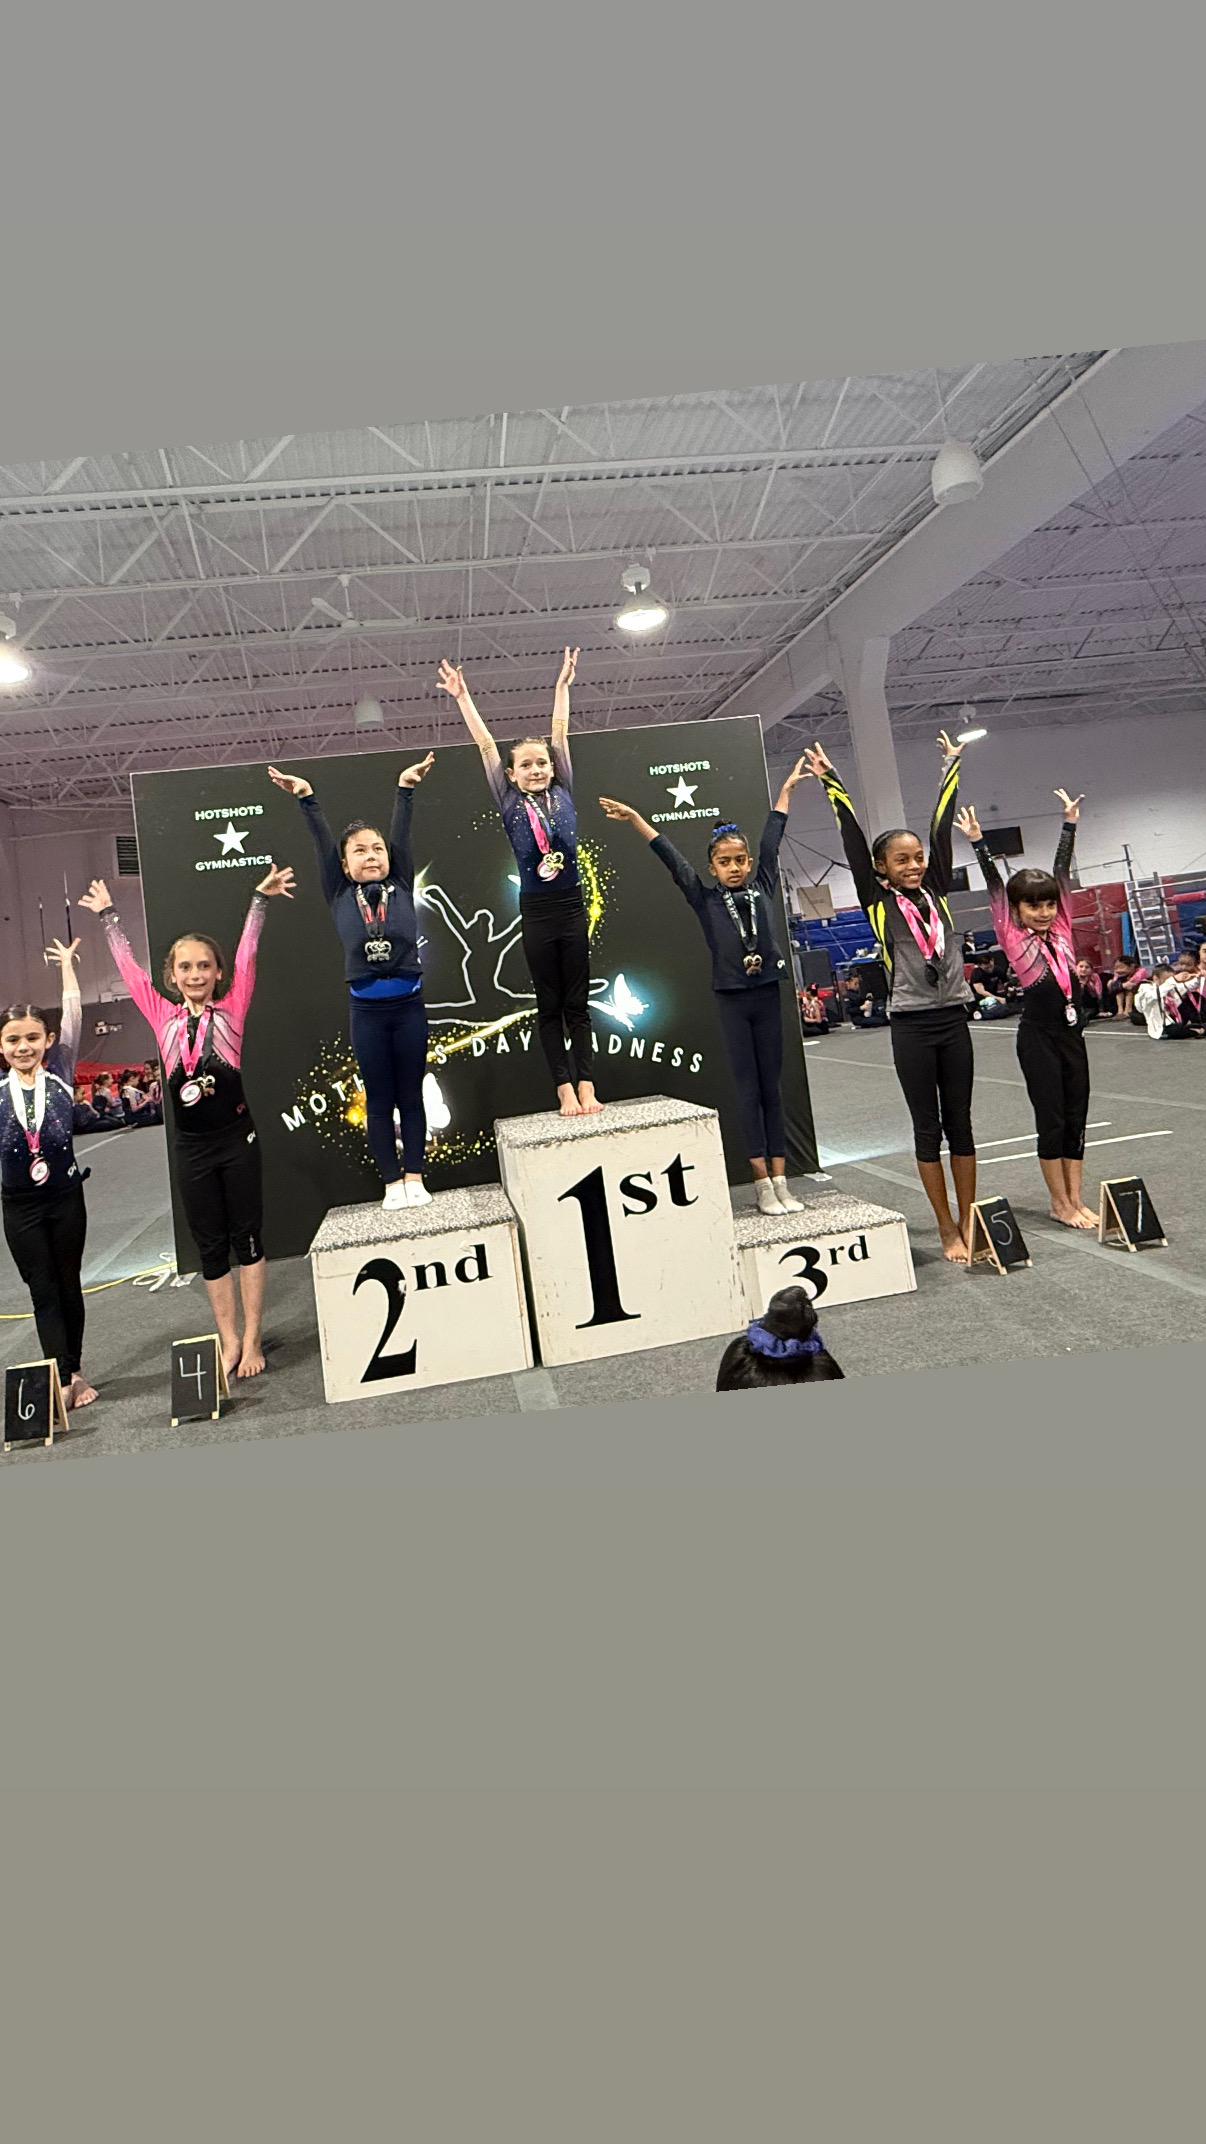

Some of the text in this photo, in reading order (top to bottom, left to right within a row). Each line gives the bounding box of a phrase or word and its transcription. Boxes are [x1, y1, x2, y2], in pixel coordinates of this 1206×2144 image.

[648, 761, 710, 775] HOTSHOTS
[195, 805, 264, 820] HOTSHOTS
[651, 808, 720, 822] GYMNASTICS
[195, 855, 273, 871] GYMNASTICS
[471, 1031, 532, 1057] DAY
[557, 1153, 699, 1329] 1st
[990, 1210, 1013, 1246] 5
[778, 1235, 871, 1301] 3rd
[352, 1243, 493, 1383] 2nd
[178, 1353, 207, 1400] 4
[18, 1378, 35, 1420] 6
